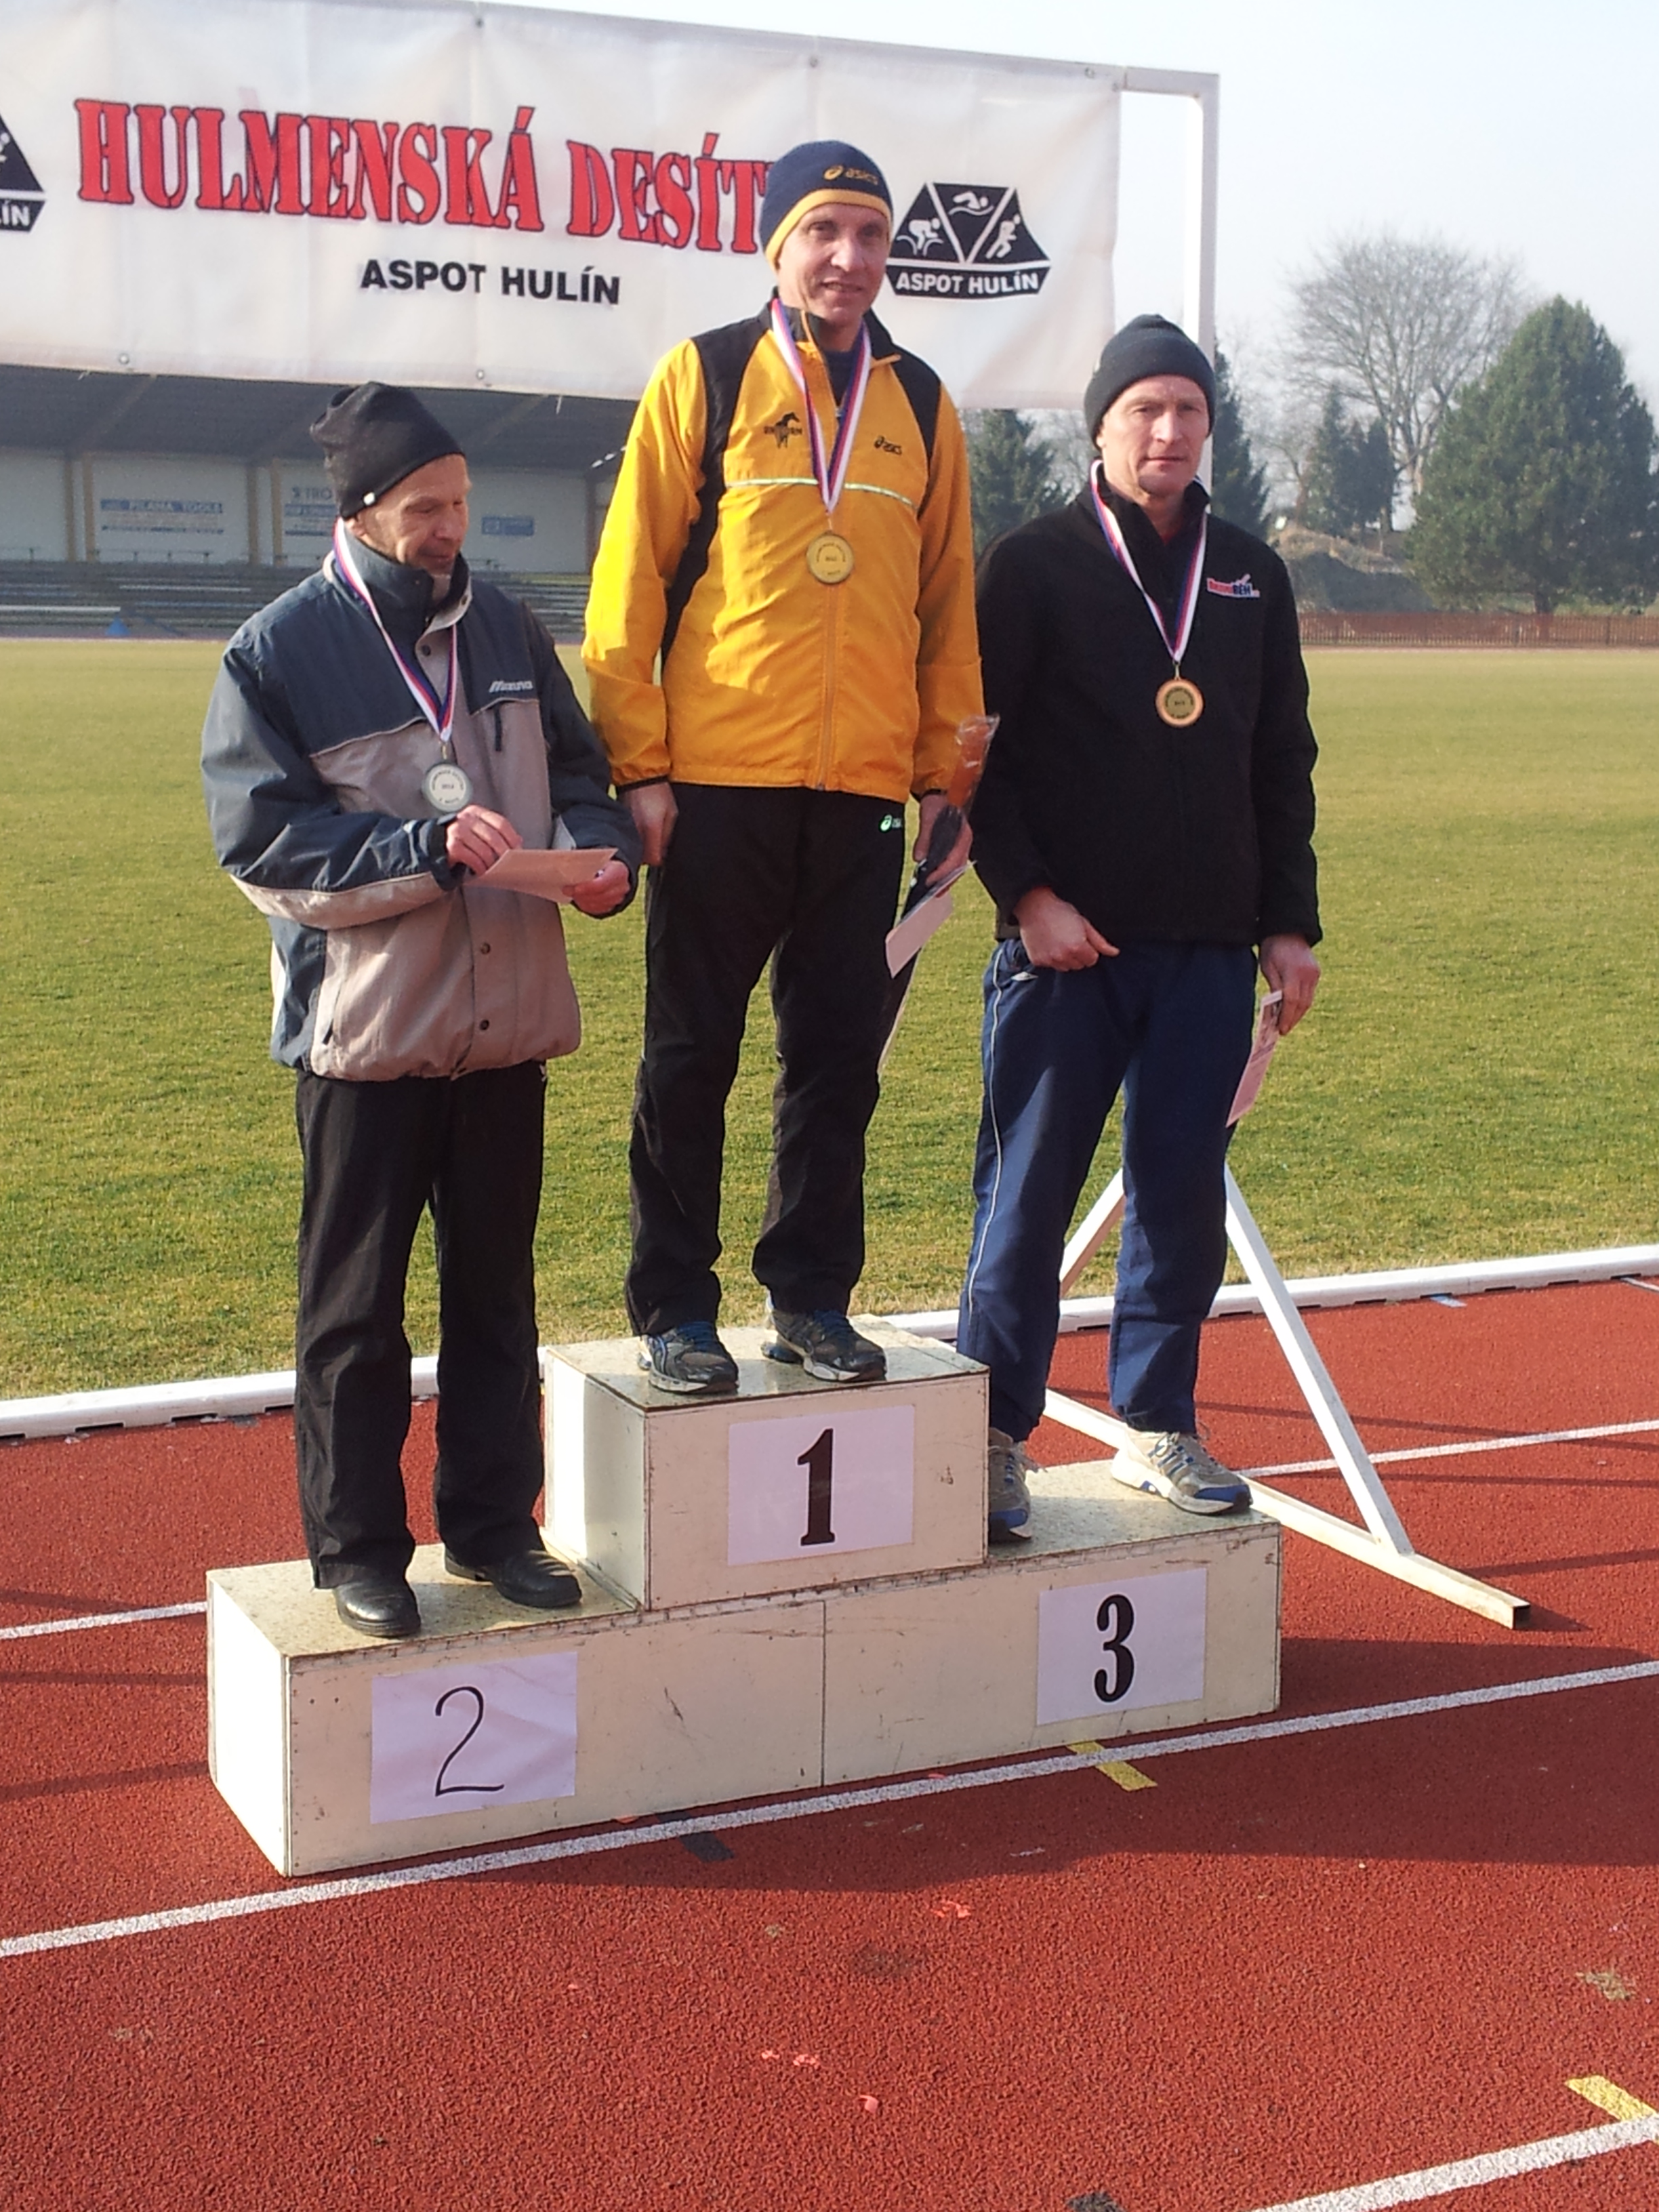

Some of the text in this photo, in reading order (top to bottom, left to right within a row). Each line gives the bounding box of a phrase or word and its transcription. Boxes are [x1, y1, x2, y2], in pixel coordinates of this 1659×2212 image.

[75, 99, 777, 254] HULMENSKÁ DESÍT
[361, 259, 620, 305] ASPOT HULÍN
[895, 271, 1039, 295] ASPOT HULÍN
[798, 1428, 836, 1547] 1
[1094, 1594, 1134, 1703] 3
[435, 1686, 505, 1797] 2
